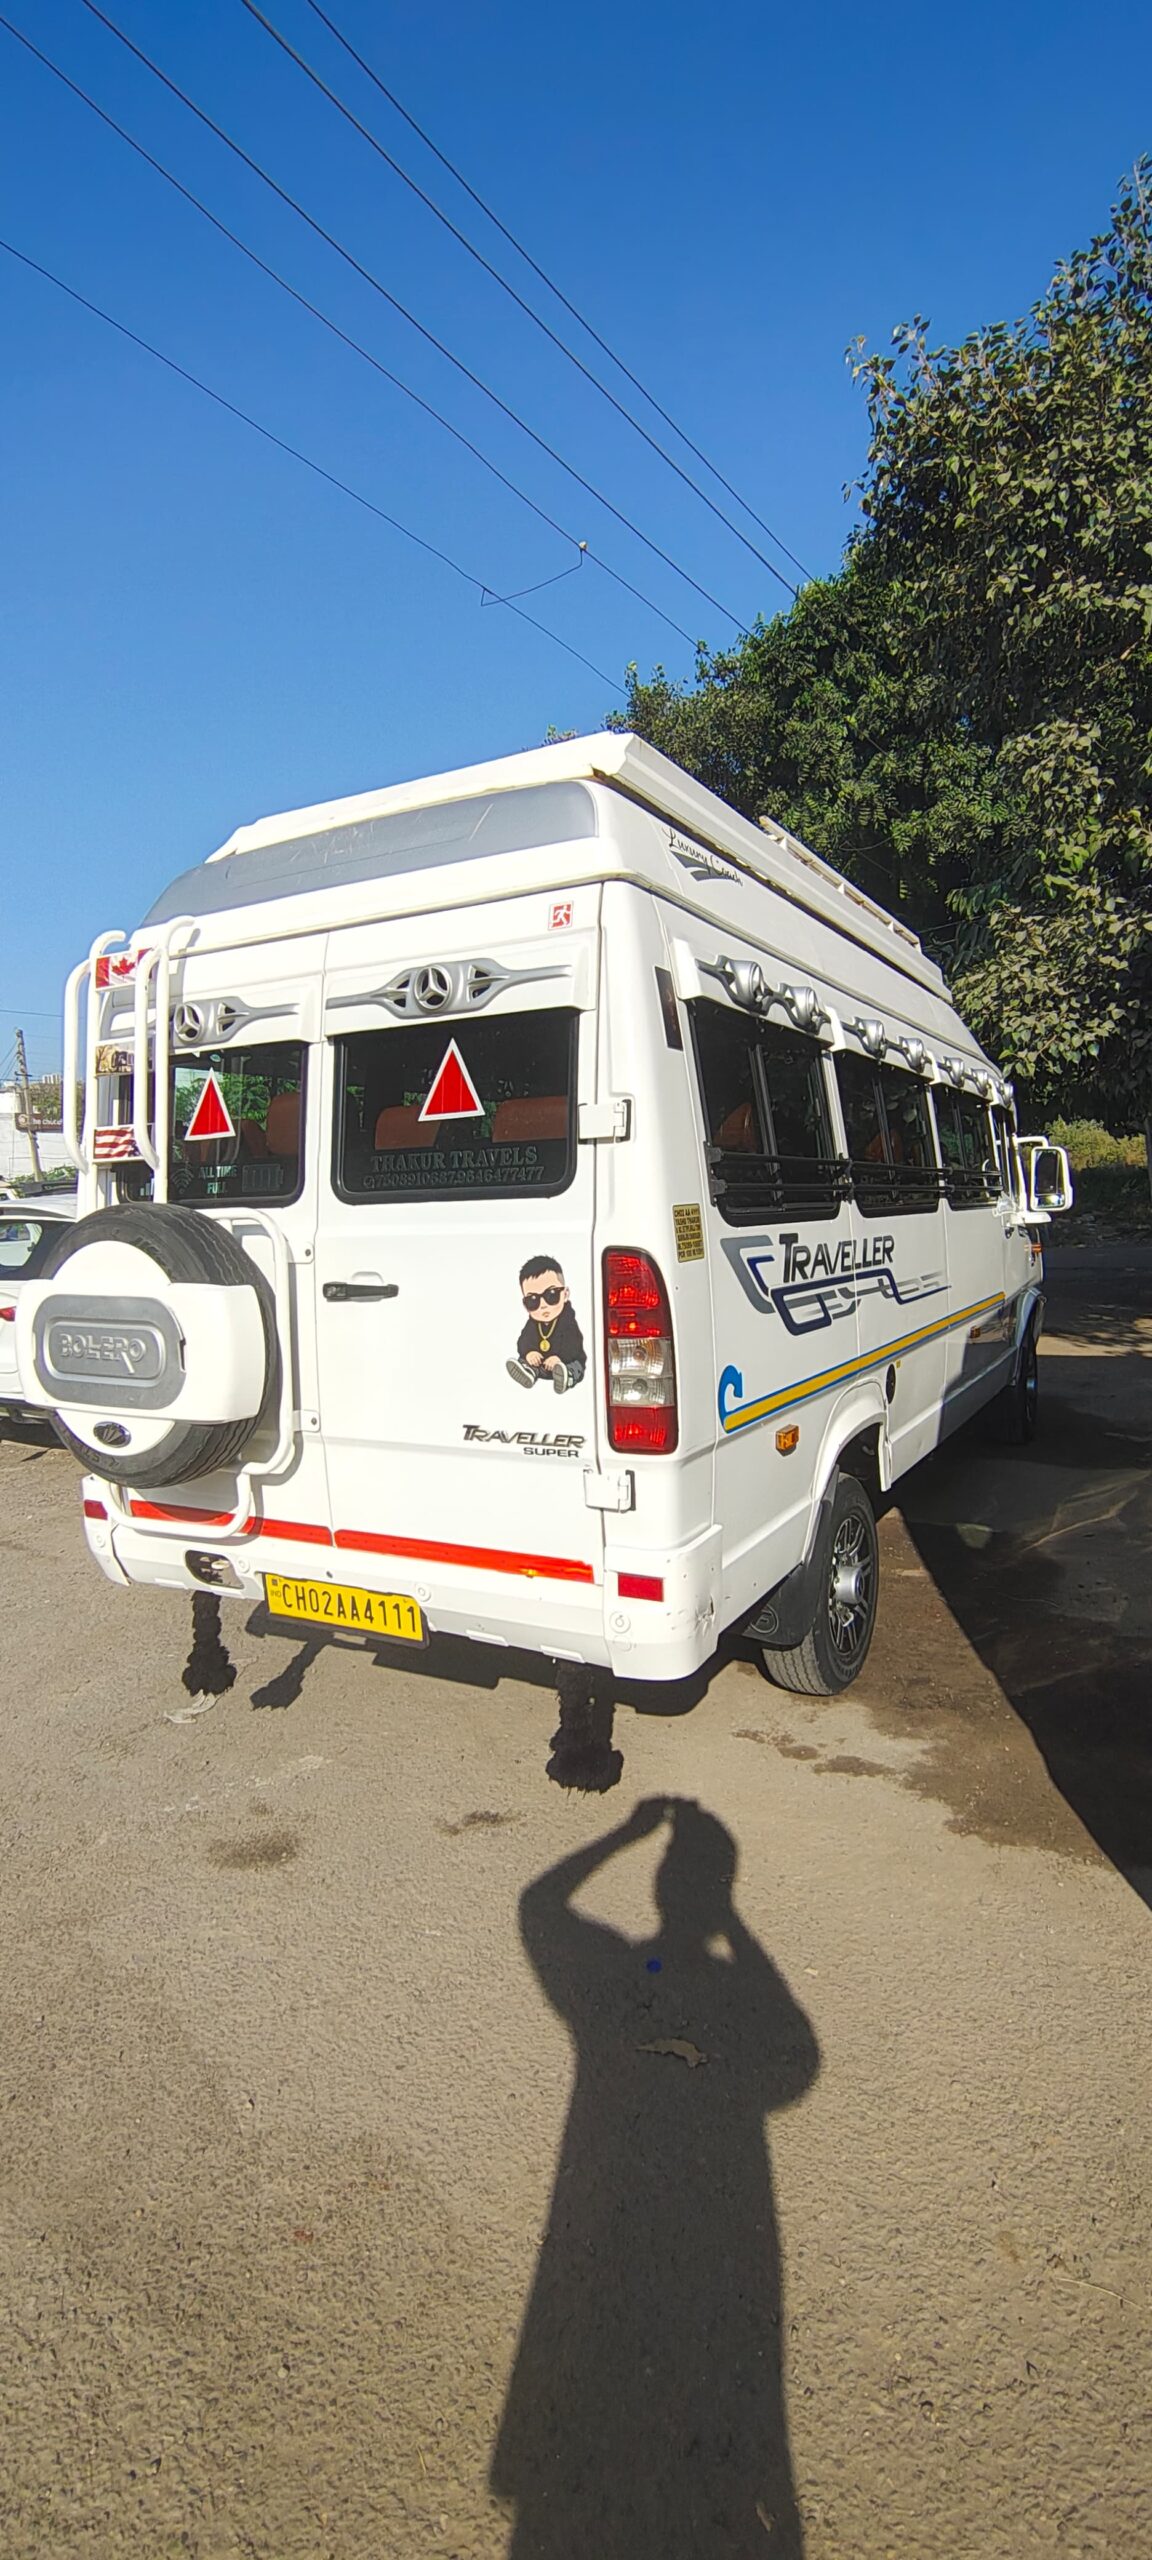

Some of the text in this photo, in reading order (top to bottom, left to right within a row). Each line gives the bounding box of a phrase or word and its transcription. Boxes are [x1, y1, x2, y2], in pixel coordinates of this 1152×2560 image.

[370, 1146, 538, 1173] THAKUR TRAVELS
[779, 1232, 895, 1284] TRAVELLER
[60, 1333, 147, 1375] BOLERO
[462, 1424, 586, 1449] TRAVELLER
[523, 1447, 580, 1458] SUPER
[282, 1583, 416, 1632] CH02AA4111
